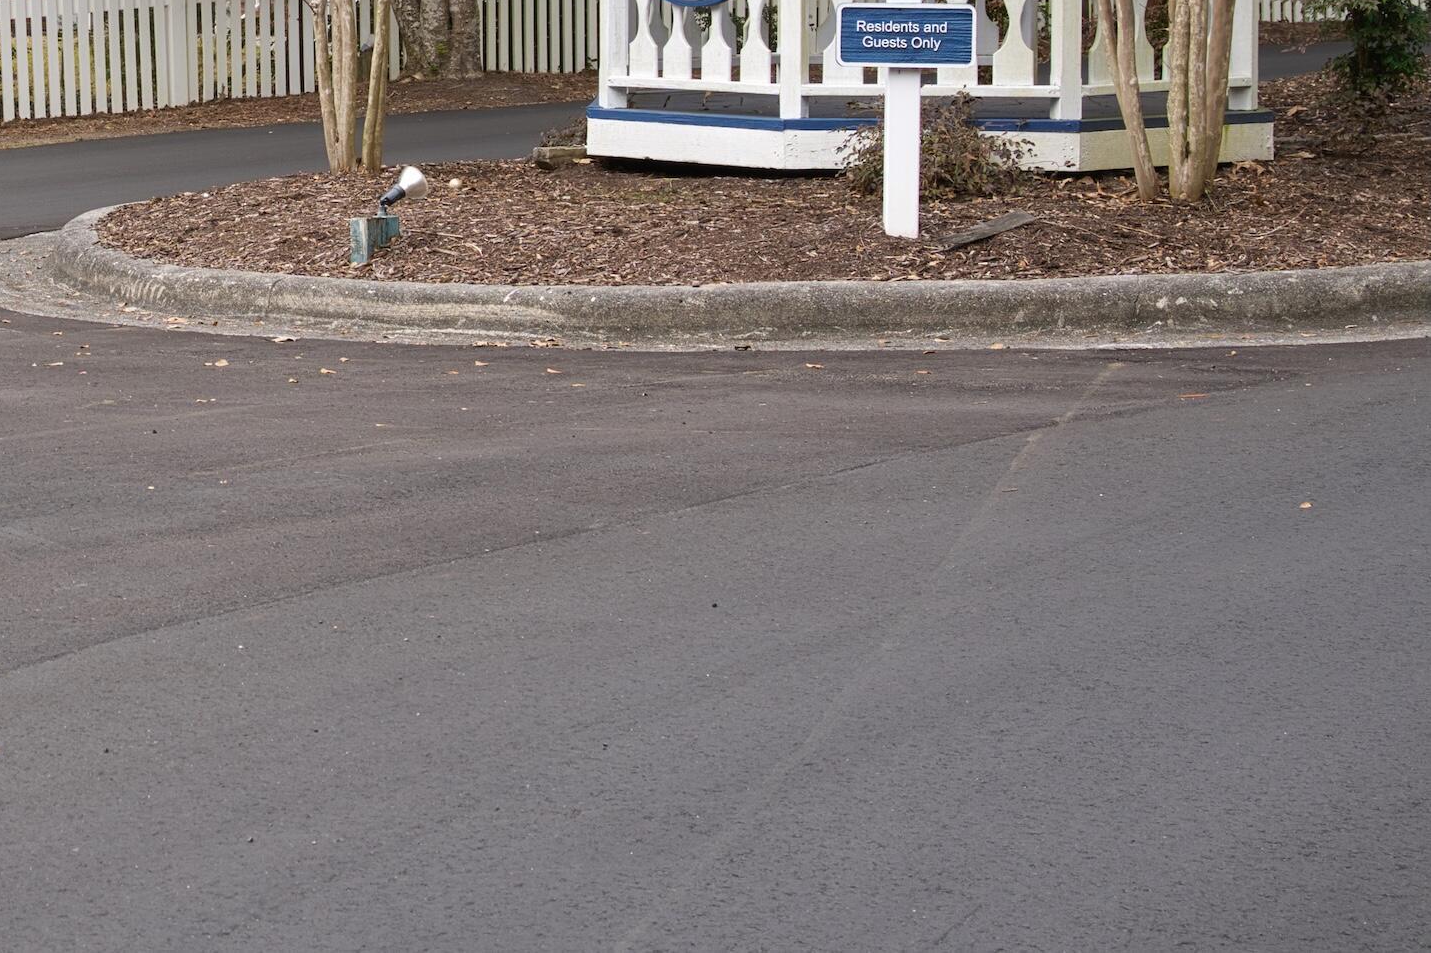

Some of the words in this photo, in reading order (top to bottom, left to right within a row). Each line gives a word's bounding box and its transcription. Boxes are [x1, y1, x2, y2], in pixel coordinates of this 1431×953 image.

[856, 20, 920, 33] Residents
[923, 21, 948, 34] and
[862, 36, 908, 49] Guests
[911, 37, 941, 52] Only
